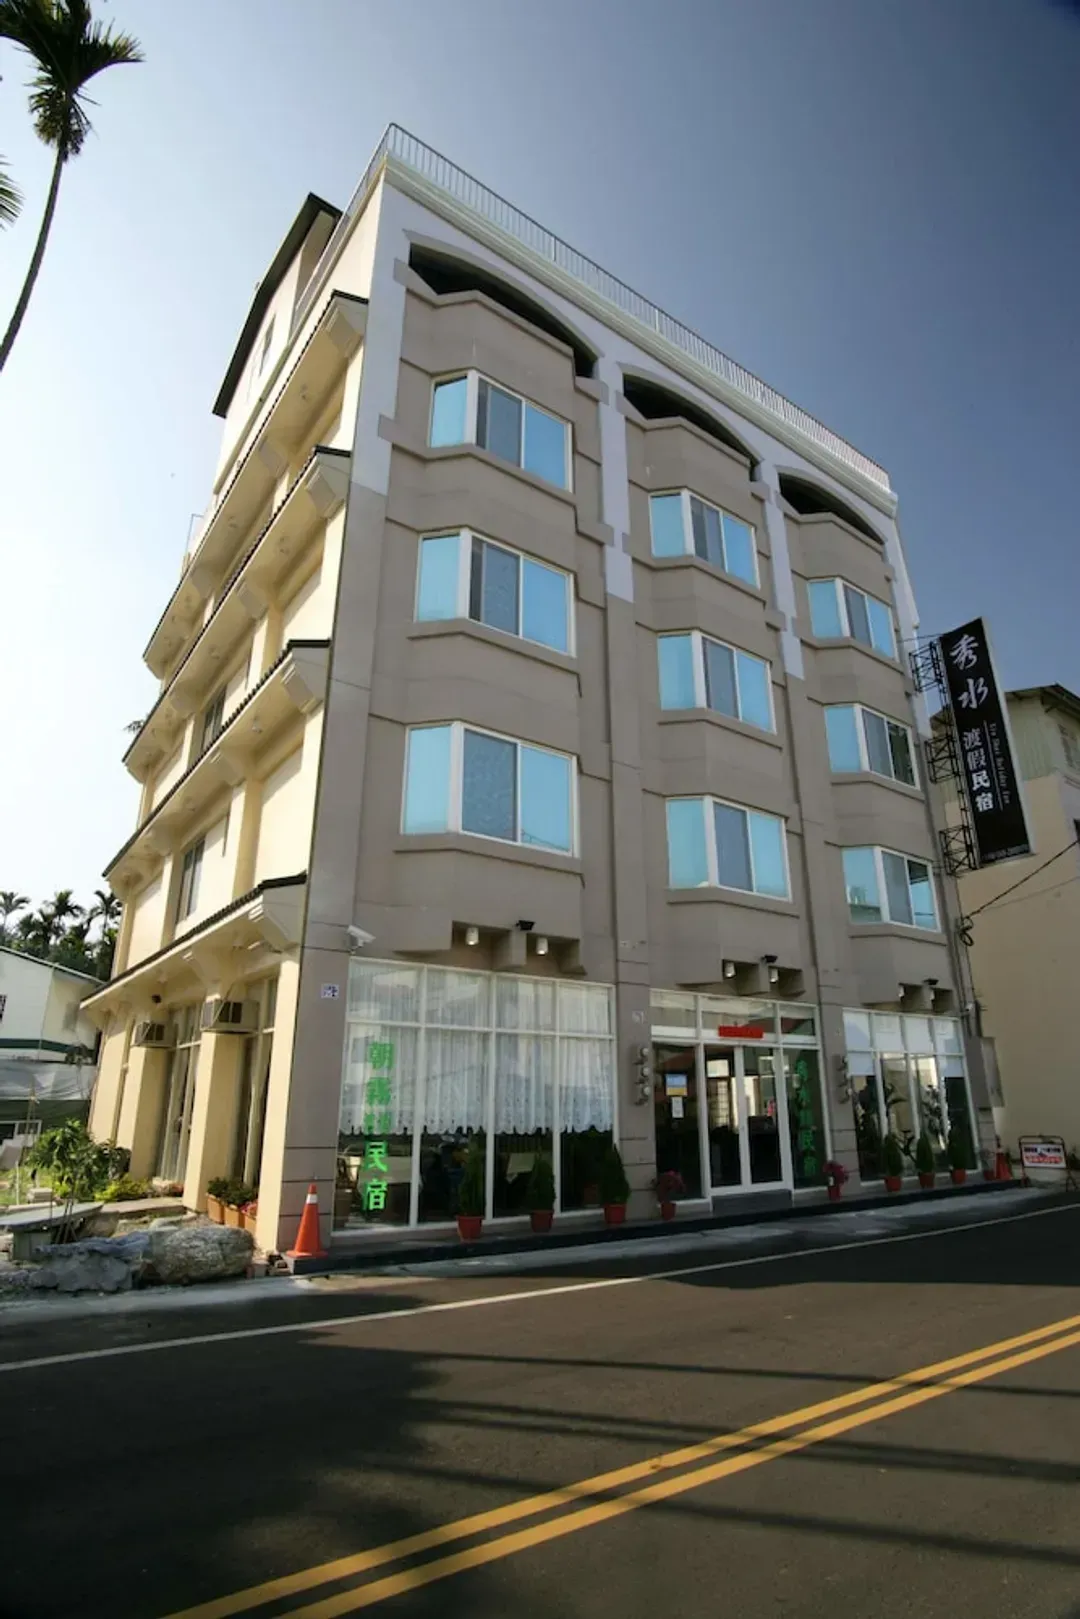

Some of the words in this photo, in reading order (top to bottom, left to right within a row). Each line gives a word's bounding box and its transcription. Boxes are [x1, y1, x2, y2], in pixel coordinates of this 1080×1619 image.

[950, 634, 988, 709] 秀水
[962, 728, 994, 812] 渡假民宿
